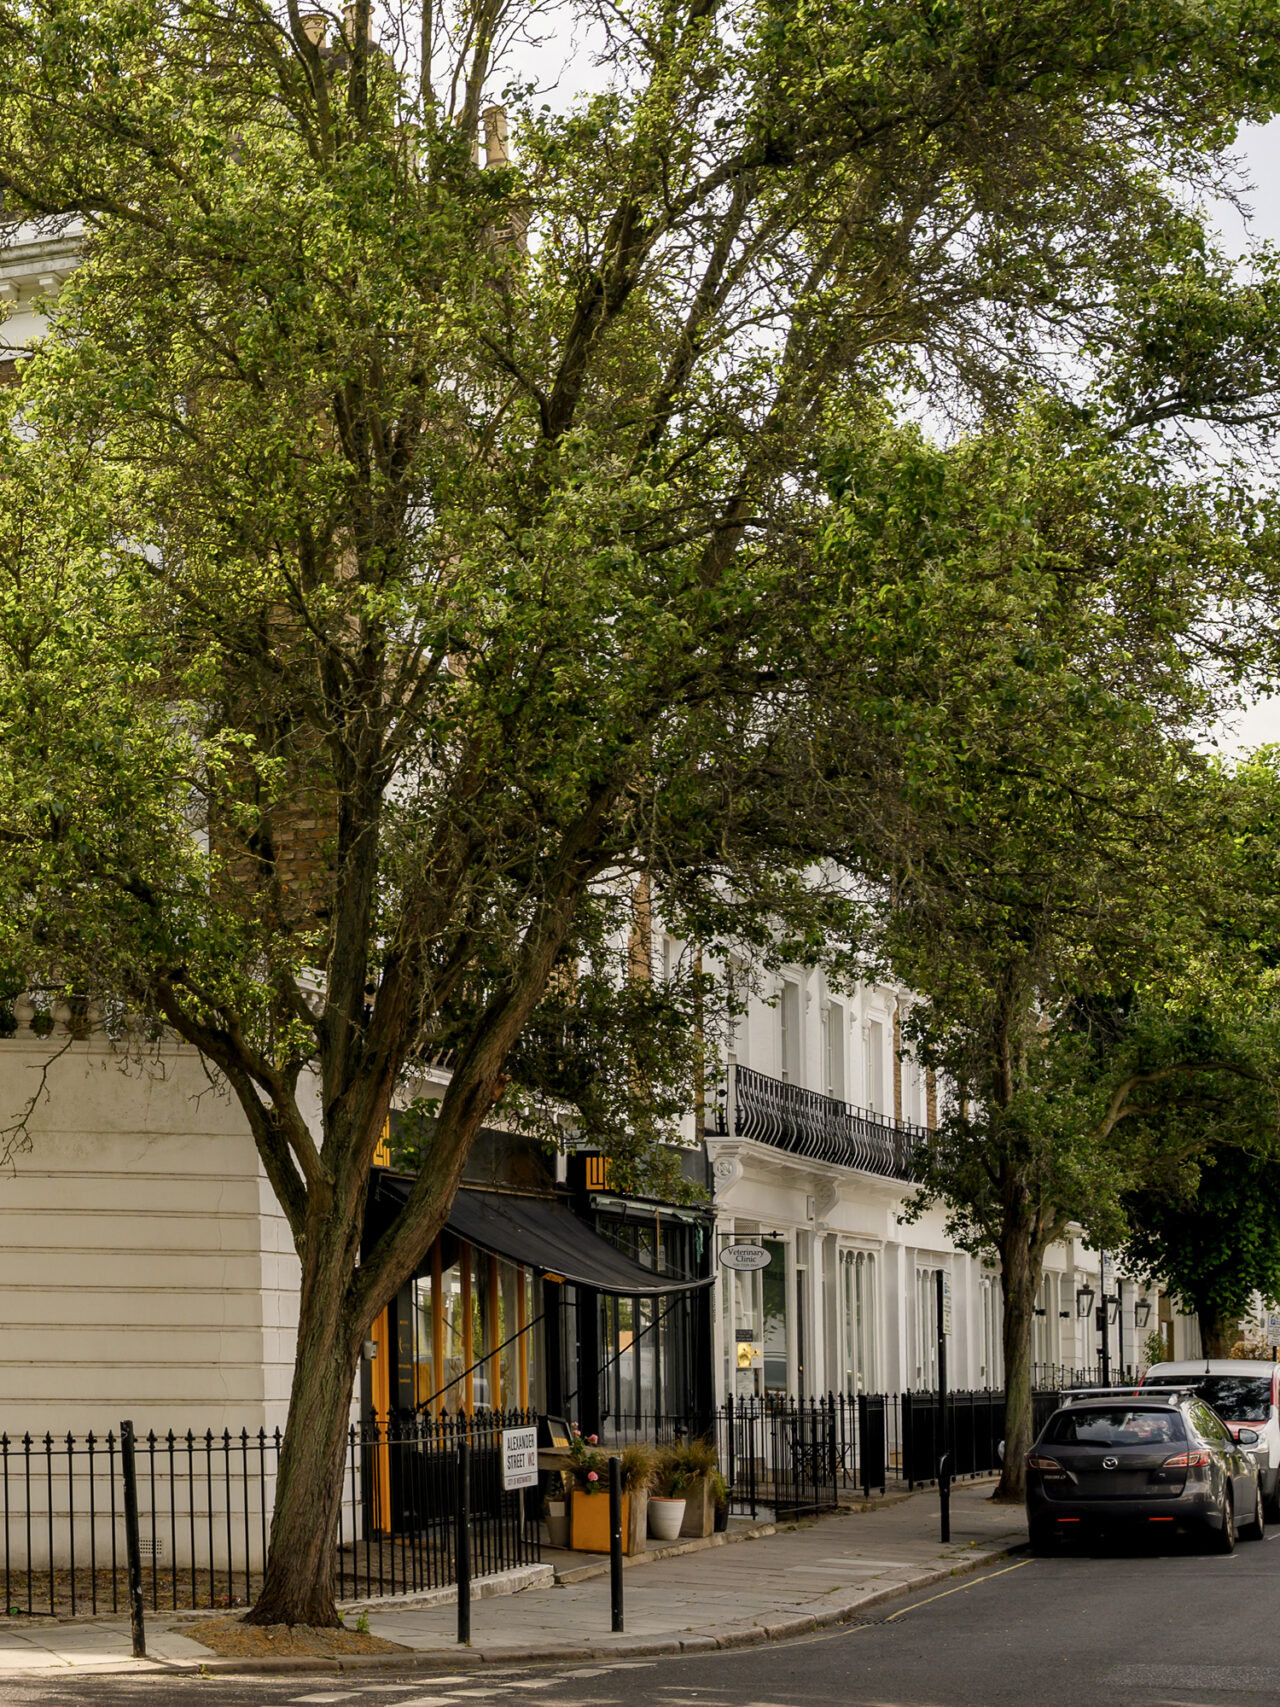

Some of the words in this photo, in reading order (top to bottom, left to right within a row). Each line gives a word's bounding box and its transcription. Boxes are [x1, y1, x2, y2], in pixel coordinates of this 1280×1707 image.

[728, 1249, 764, 1258] Veterinary
[507, 1433, 535, 1451] ALEXANDER
[507, 1453, 525, 1470] STREET
[527, 1452, 535, 1467] W2
